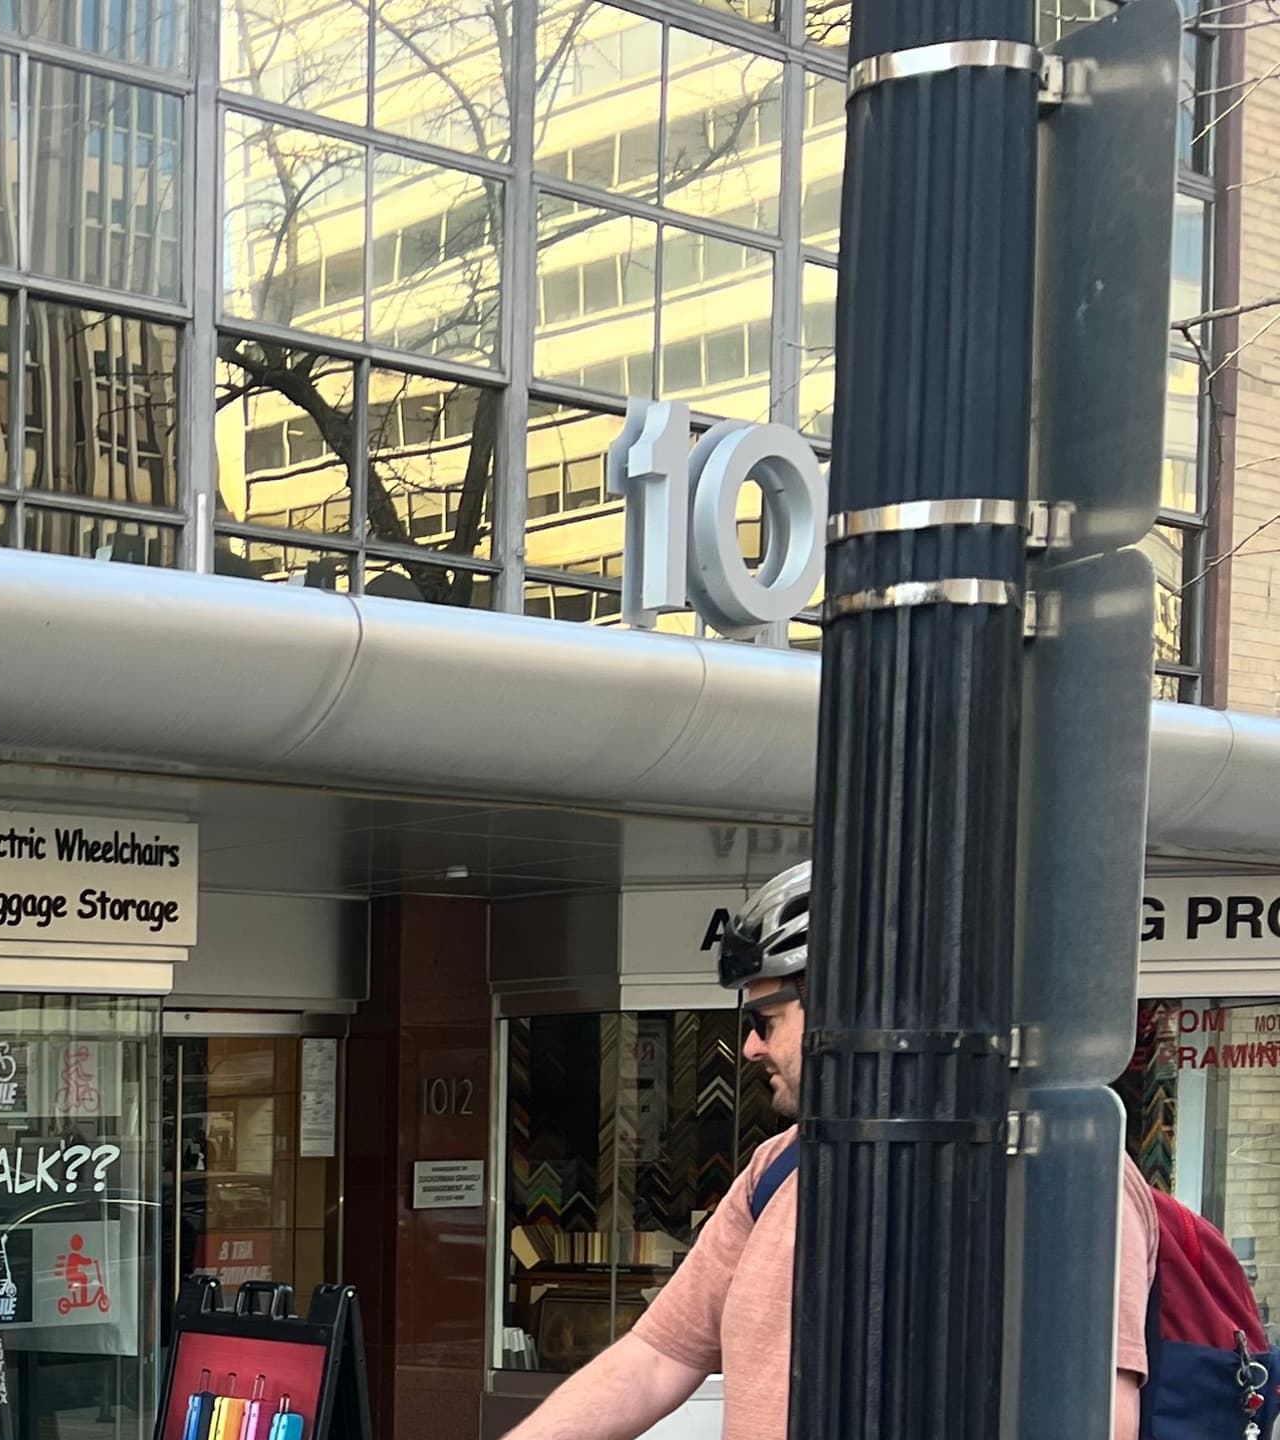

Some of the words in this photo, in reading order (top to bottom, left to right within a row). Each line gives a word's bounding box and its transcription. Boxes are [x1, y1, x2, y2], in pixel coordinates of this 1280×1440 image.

[55, 828, 181, 868] Wheelchairs
[77, 889, 179, 931] Storage
[1186, 896, 1280, 940] PR
[422, 1078, 474, 1116] 1012
